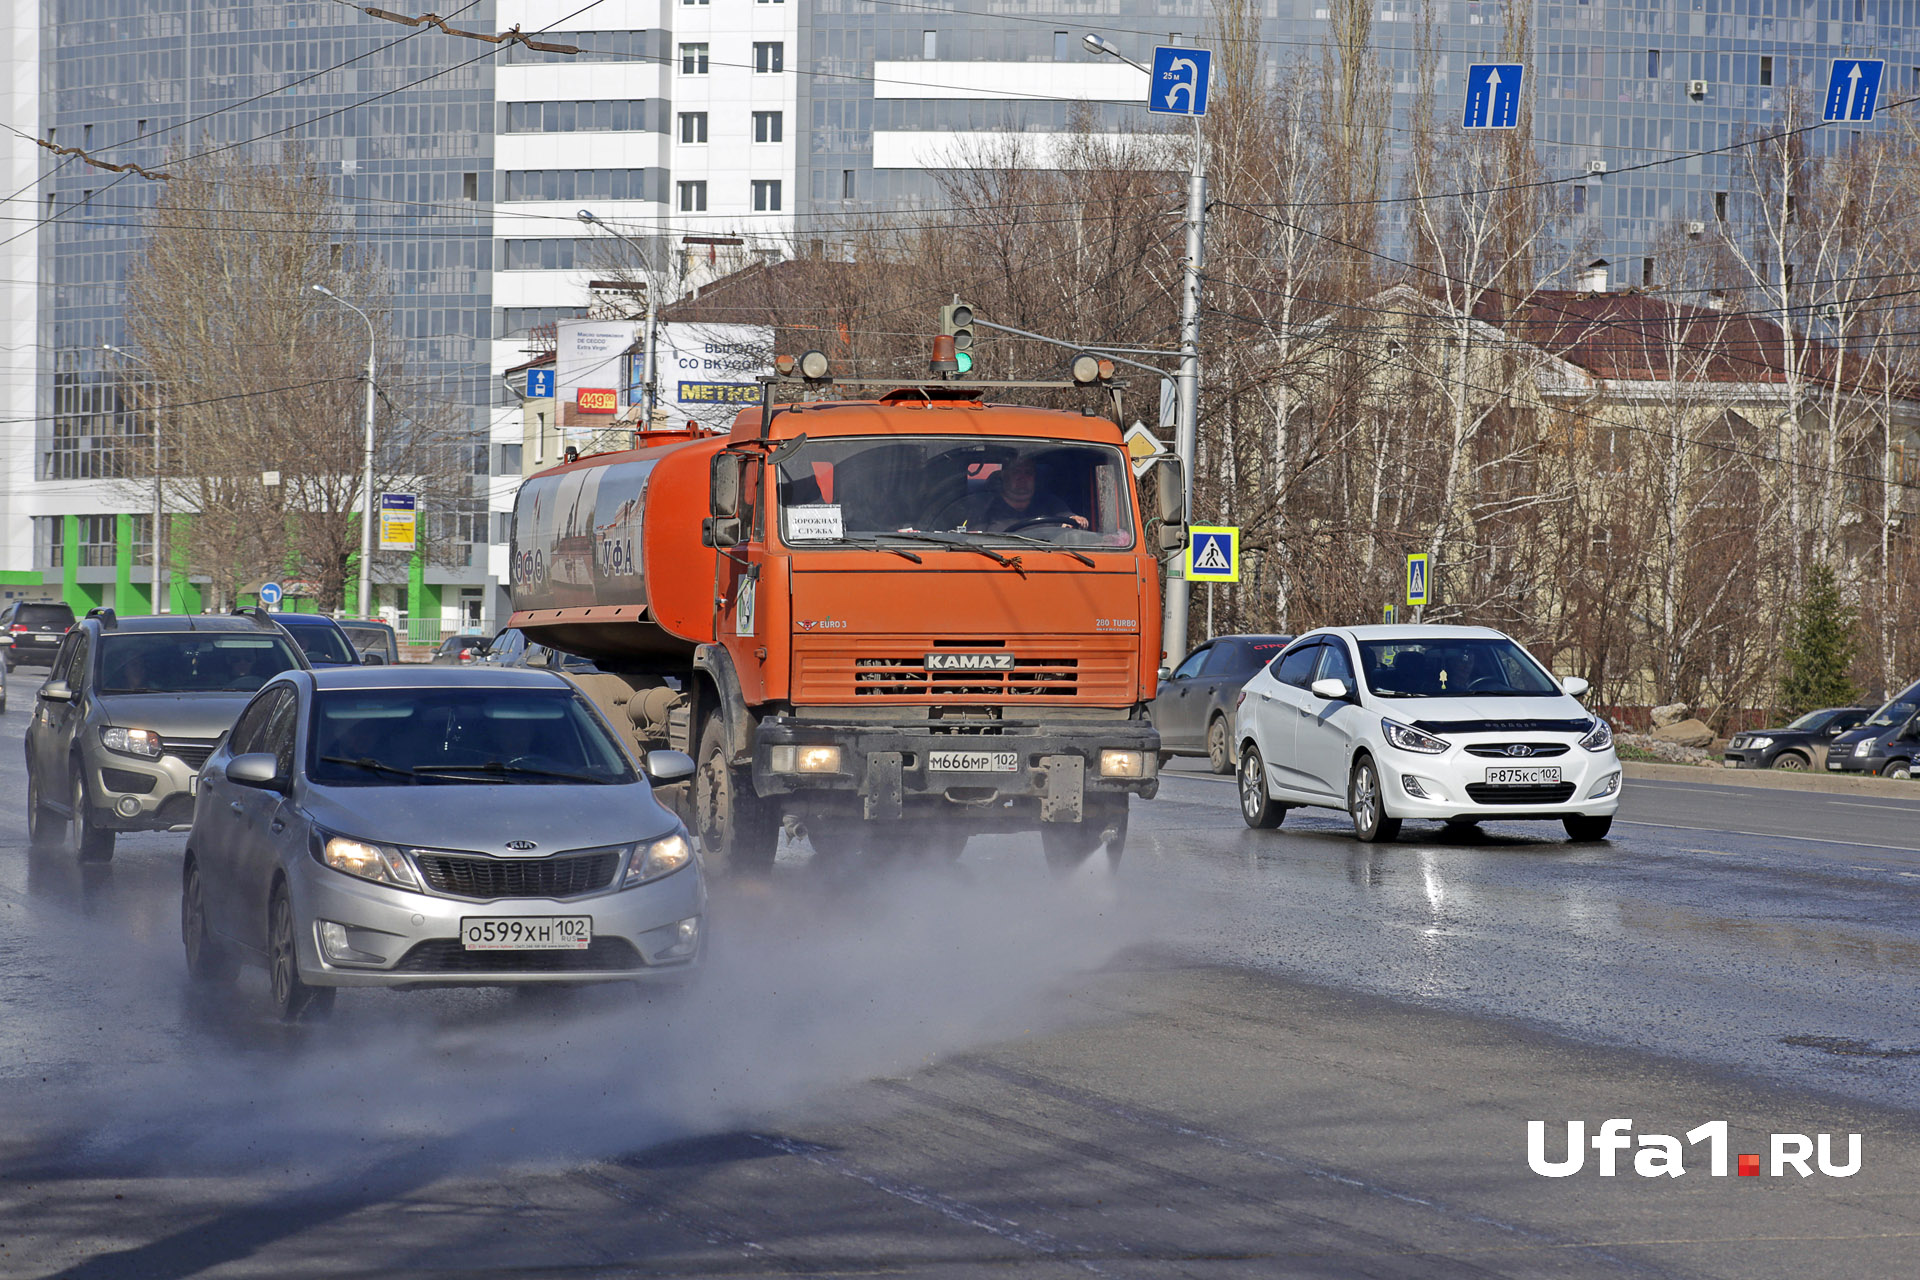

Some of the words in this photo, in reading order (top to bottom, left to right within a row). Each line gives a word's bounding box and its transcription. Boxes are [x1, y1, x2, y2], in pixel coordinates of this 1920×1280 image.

[1163, 72, 1173, 80] 25
[705, 343, 764, 354] ВЫГОДА
[679, 358, 699, 369] СО
[704, 359, 762, 370] ВКУСОМ
[681, 384, 760, 402] METRO
[798, 527, 833, 535] СЛУЖБА
[603, 538, 634, 577] УФА
[819, 620, 841, 628] EURO
[842, 620, 847, 628] 3
[1096, 618, 1110, 627] 280
[1112, 619, 1137, 627] TURBO
[928, 656, 1011, 668] KAMAZ
[932, 754, 989, 769] М666МР
[994, 754, 1016, 765] 102
[1490, 769, 1538, 783] Р875КС
[1540, 769, 1558, 778] 102
[510, 841, 533, 849] KIA
[469, 921, 550, 942] О599ХН
[555, 920, 585, 936] 102
